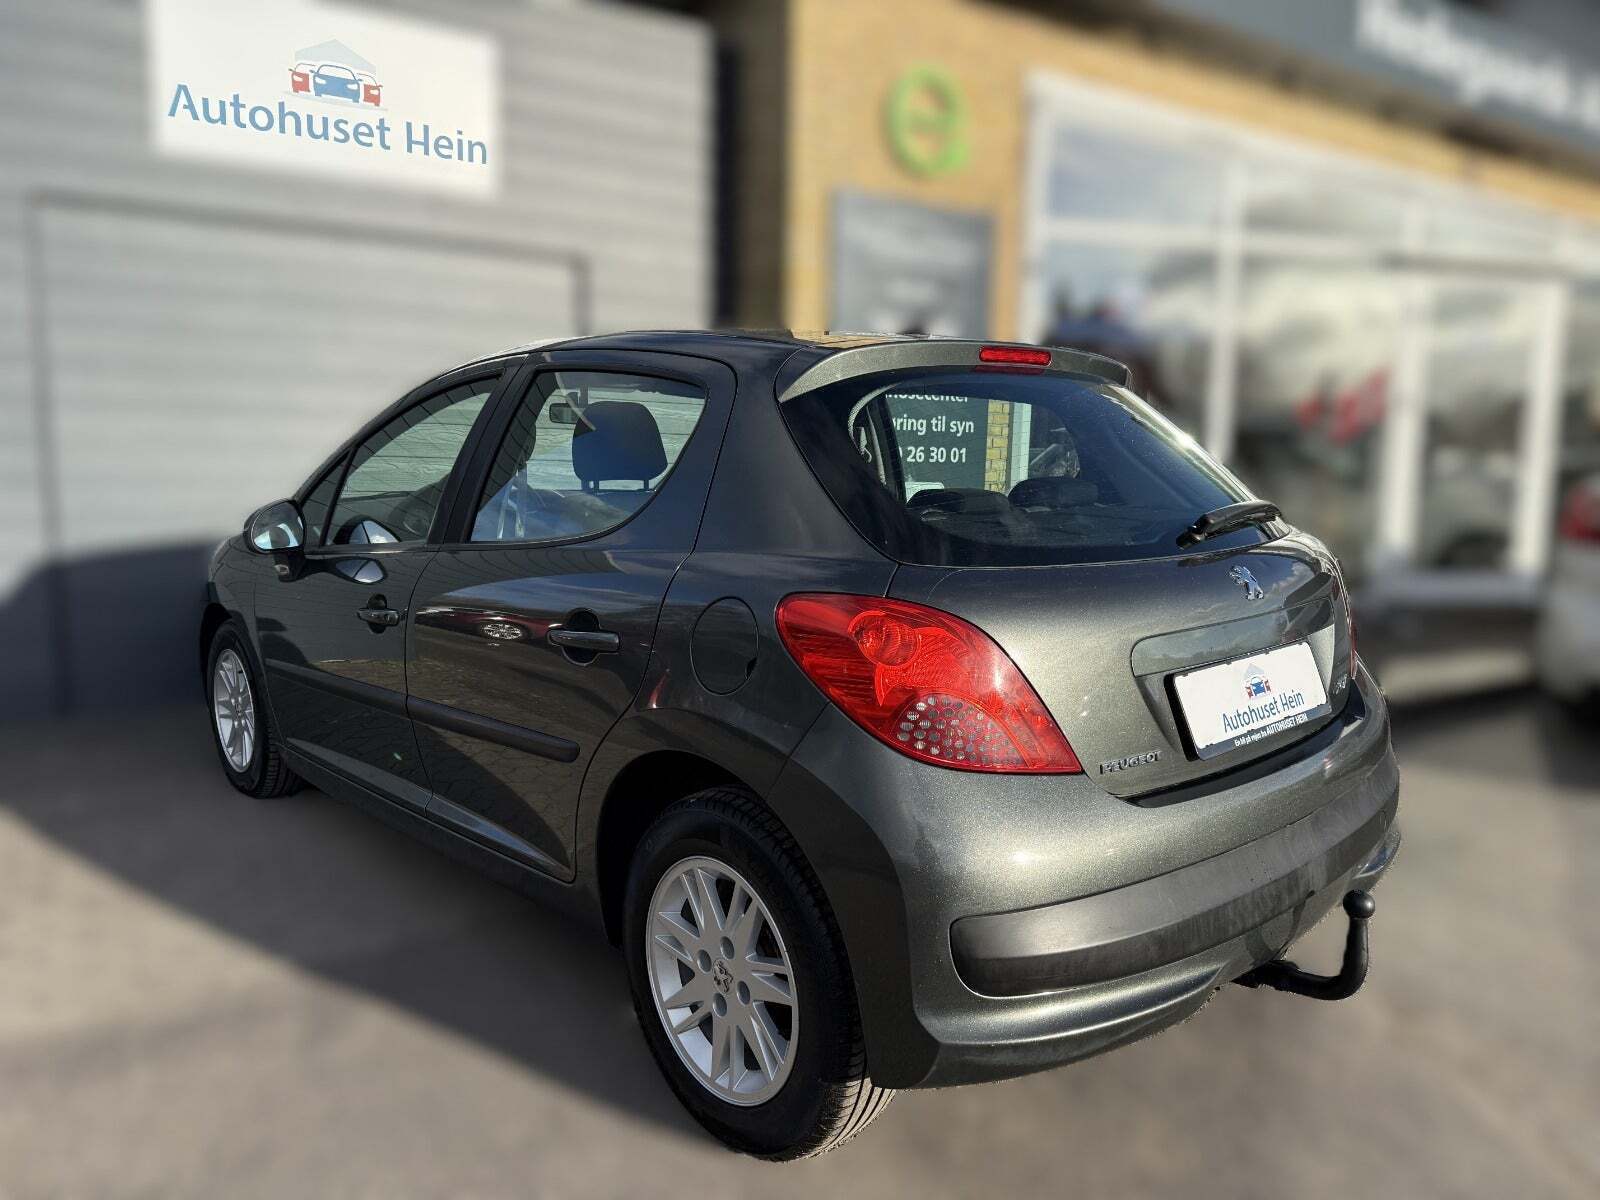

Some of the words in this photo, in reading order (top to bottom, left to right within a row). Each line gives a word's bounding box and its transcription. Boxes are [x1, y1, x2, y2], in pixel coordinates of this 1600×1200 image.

[168, 83, 391, 151] Autohuset
[405, 121, 488, 164] Hein
[930, 415, 946, 432] til
[949, 420, 975, 437] syn
[906, 446, 925, 462] 26
[928, 446, 947, 463] 30
[950, 447, 967, 463] 01
[1222, 697, 1280, 733] Autohuset
[1280, 690, 1305, 712] Hein
[1266, 717, 1296, 735] AUTOHUSET
[1099, 751, 1162, 774] PEUGEOT
